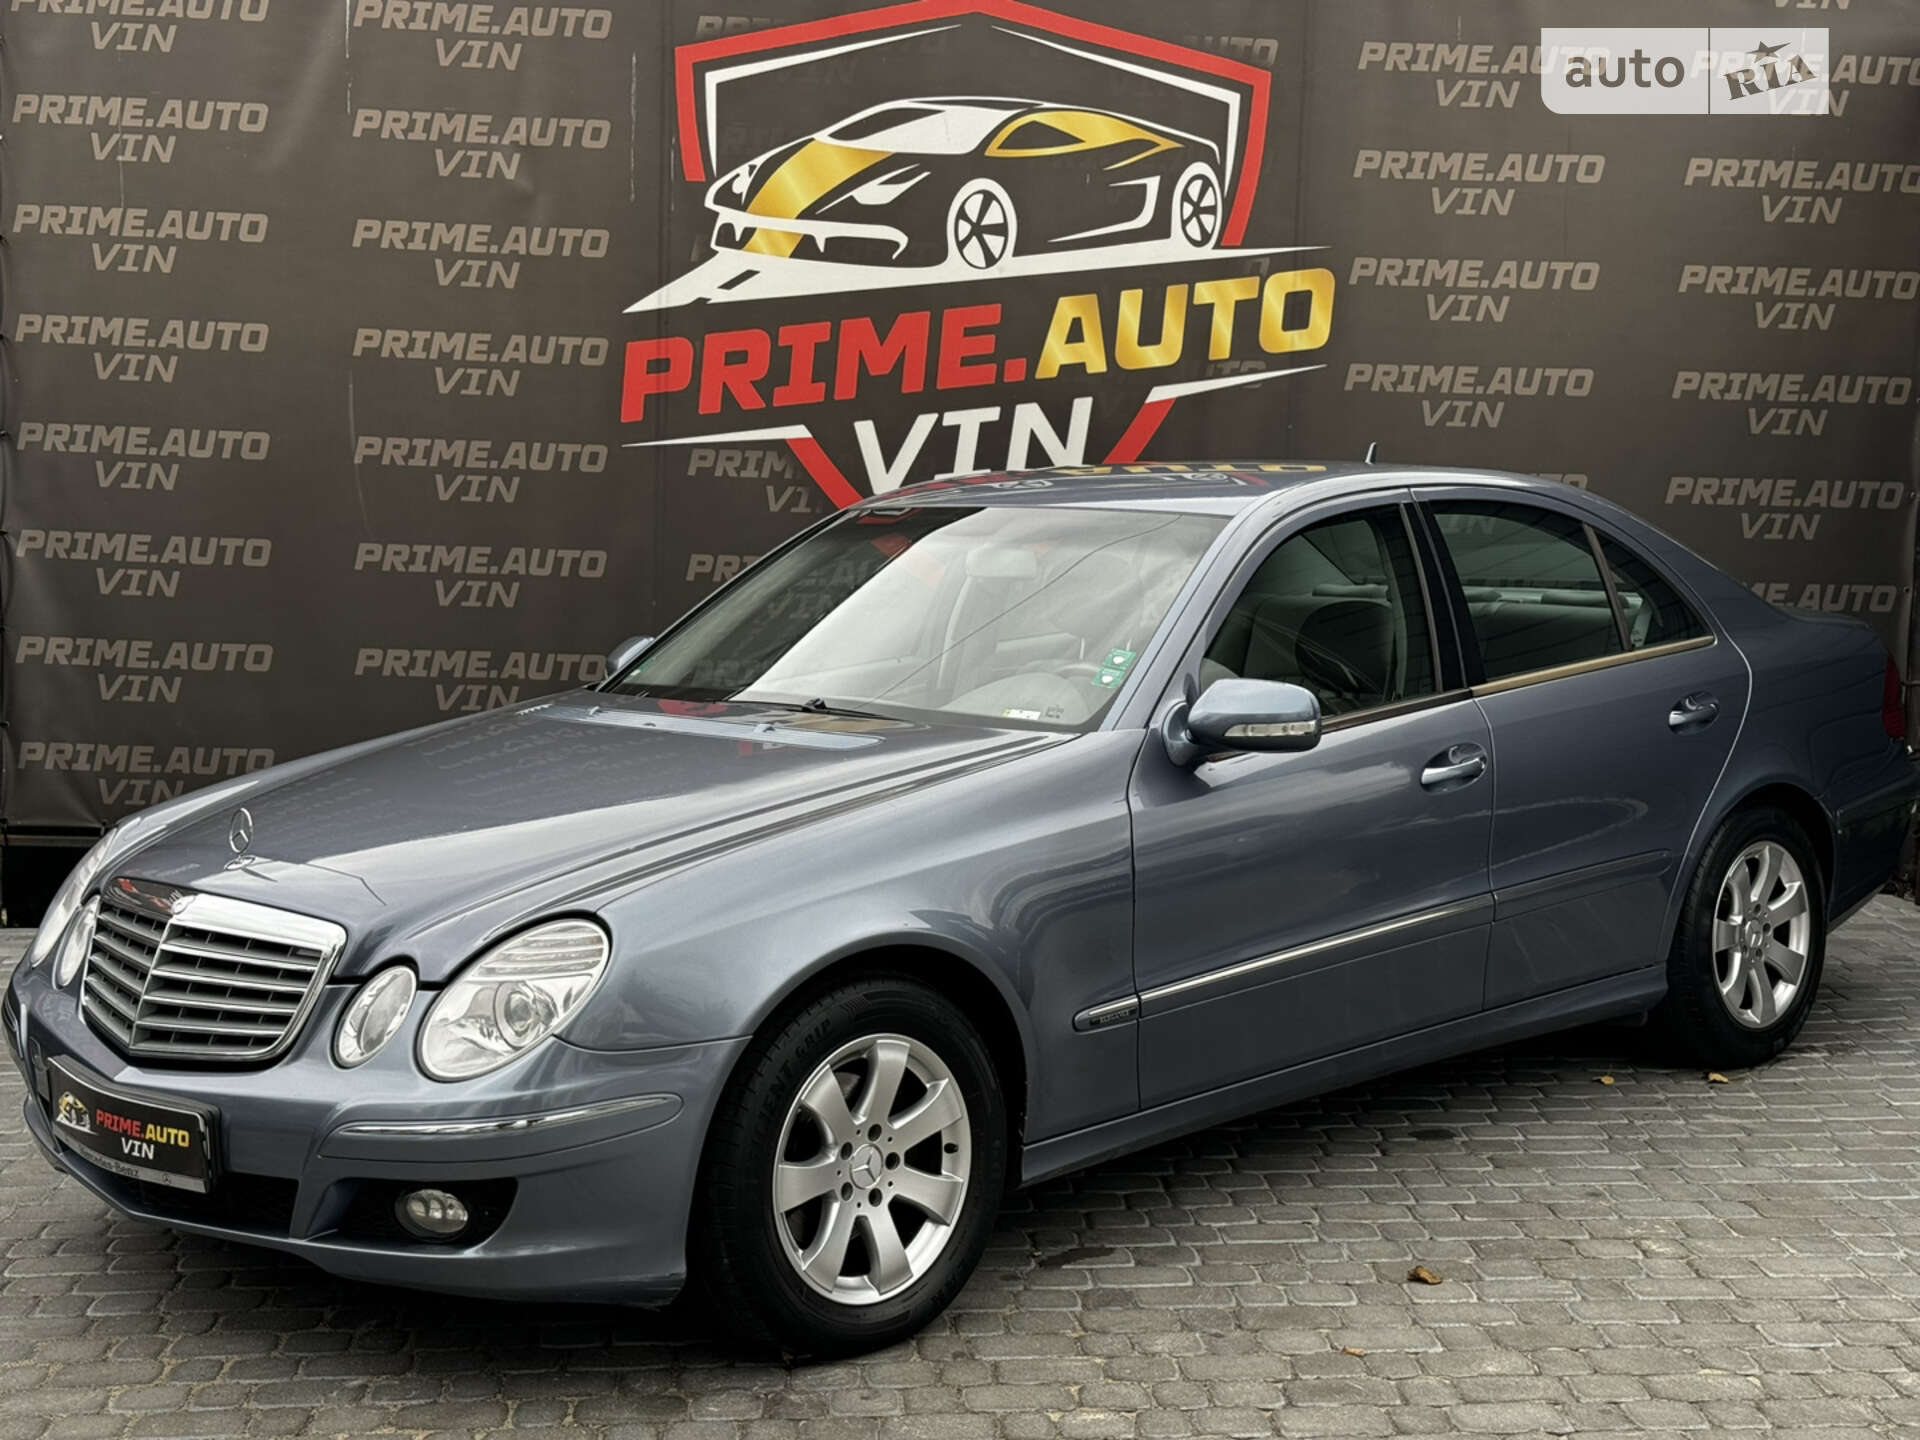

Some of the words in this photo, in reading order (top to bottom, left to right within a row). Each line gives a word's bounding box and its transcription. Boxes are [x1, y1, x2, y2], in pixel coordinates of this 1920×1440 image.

[354, 0, 612, 40] PRIME.AUTO
[92, 22, 177, 52] VIN
[436, 39, 522, 70] VIN
[1437, 80, 1520, 108] VIN
[13, 94, 268, 133] PRIME.AUTO
[353, 109, 610, 150] PRIME.AUTO
[91, 133, 176, 163] VIN
[435, 149, 520, 180] VIN
[1354, 150, 1605, 183] PRIME.AUTO
[1684, 158, 1920, 193] PRIME.AUTO
[1432, 187, 1515, 215] VIN
[1763, 195, 1842, 224] VIN
[13, 204, 268, 243] PRIME.AUTO
[352, 219, 609, 259] PRIME.AUTO
[92, 243, 176, 273] VIN
[435, 259, 520, 288] VIN
[1349, 258, 1600, 290] PRIME.AUTO
[1678, 265, 1920, 299] PRIME.AUTO
[1427, 294, 1510, 322] VIN
[1756, 302, 1835, 330] VIN
[15, 314, 269, 353] PRIME.AUTO
[353, 328, 608, 367] PRIME.AUTO
[621, 268, 1336, 423] PRIME.AUTO
[94, 353, 178, 382] VIN
[435, 367, 520, 396] VIN
[1344, 364, 1594, 396] PRIME.AUTO
[1672, 371, 1912, 404] PRIME.AUTO
[1422, 400, 1504, 427] VIN
[1749, 408, 1828, 435] VIN
[18, 422, 270, 461] PRIME.AUTO
[354, 436, 608, 472] PRIME.AUTO
[853, 397, 1094, 494] VIN
[96, 461, 179, 490] VIN
[435, 474, 520, 503] VIN
[1665, 477, 1904, 509] PRIME.AUTO
[1741, 513, 1821, 540] VIN
[16, 529, 271, 568] PRIME.AUTO
[354, 543, 607, 577] PRIME.AUTO
[96, 568, 180, 597] VIN
[436, 580, 520, 607] VIN
[1752, 583, 1897, 612] E.AUTO
[16, 636, 273, 672] PRIME.AUTO
[354, 648, 606, 681] PRIME.AUTO
[98, 674, 182, 703] VIN
[435, 685, 520, 712] VIN
[19, 742, 276, 776] PRIME.AUTO
[99, 779, 185, 805] VIN
[96, 1109, 190, 1147] PRIME.AUTO
[121, 1137, 155, 1161] VIN
